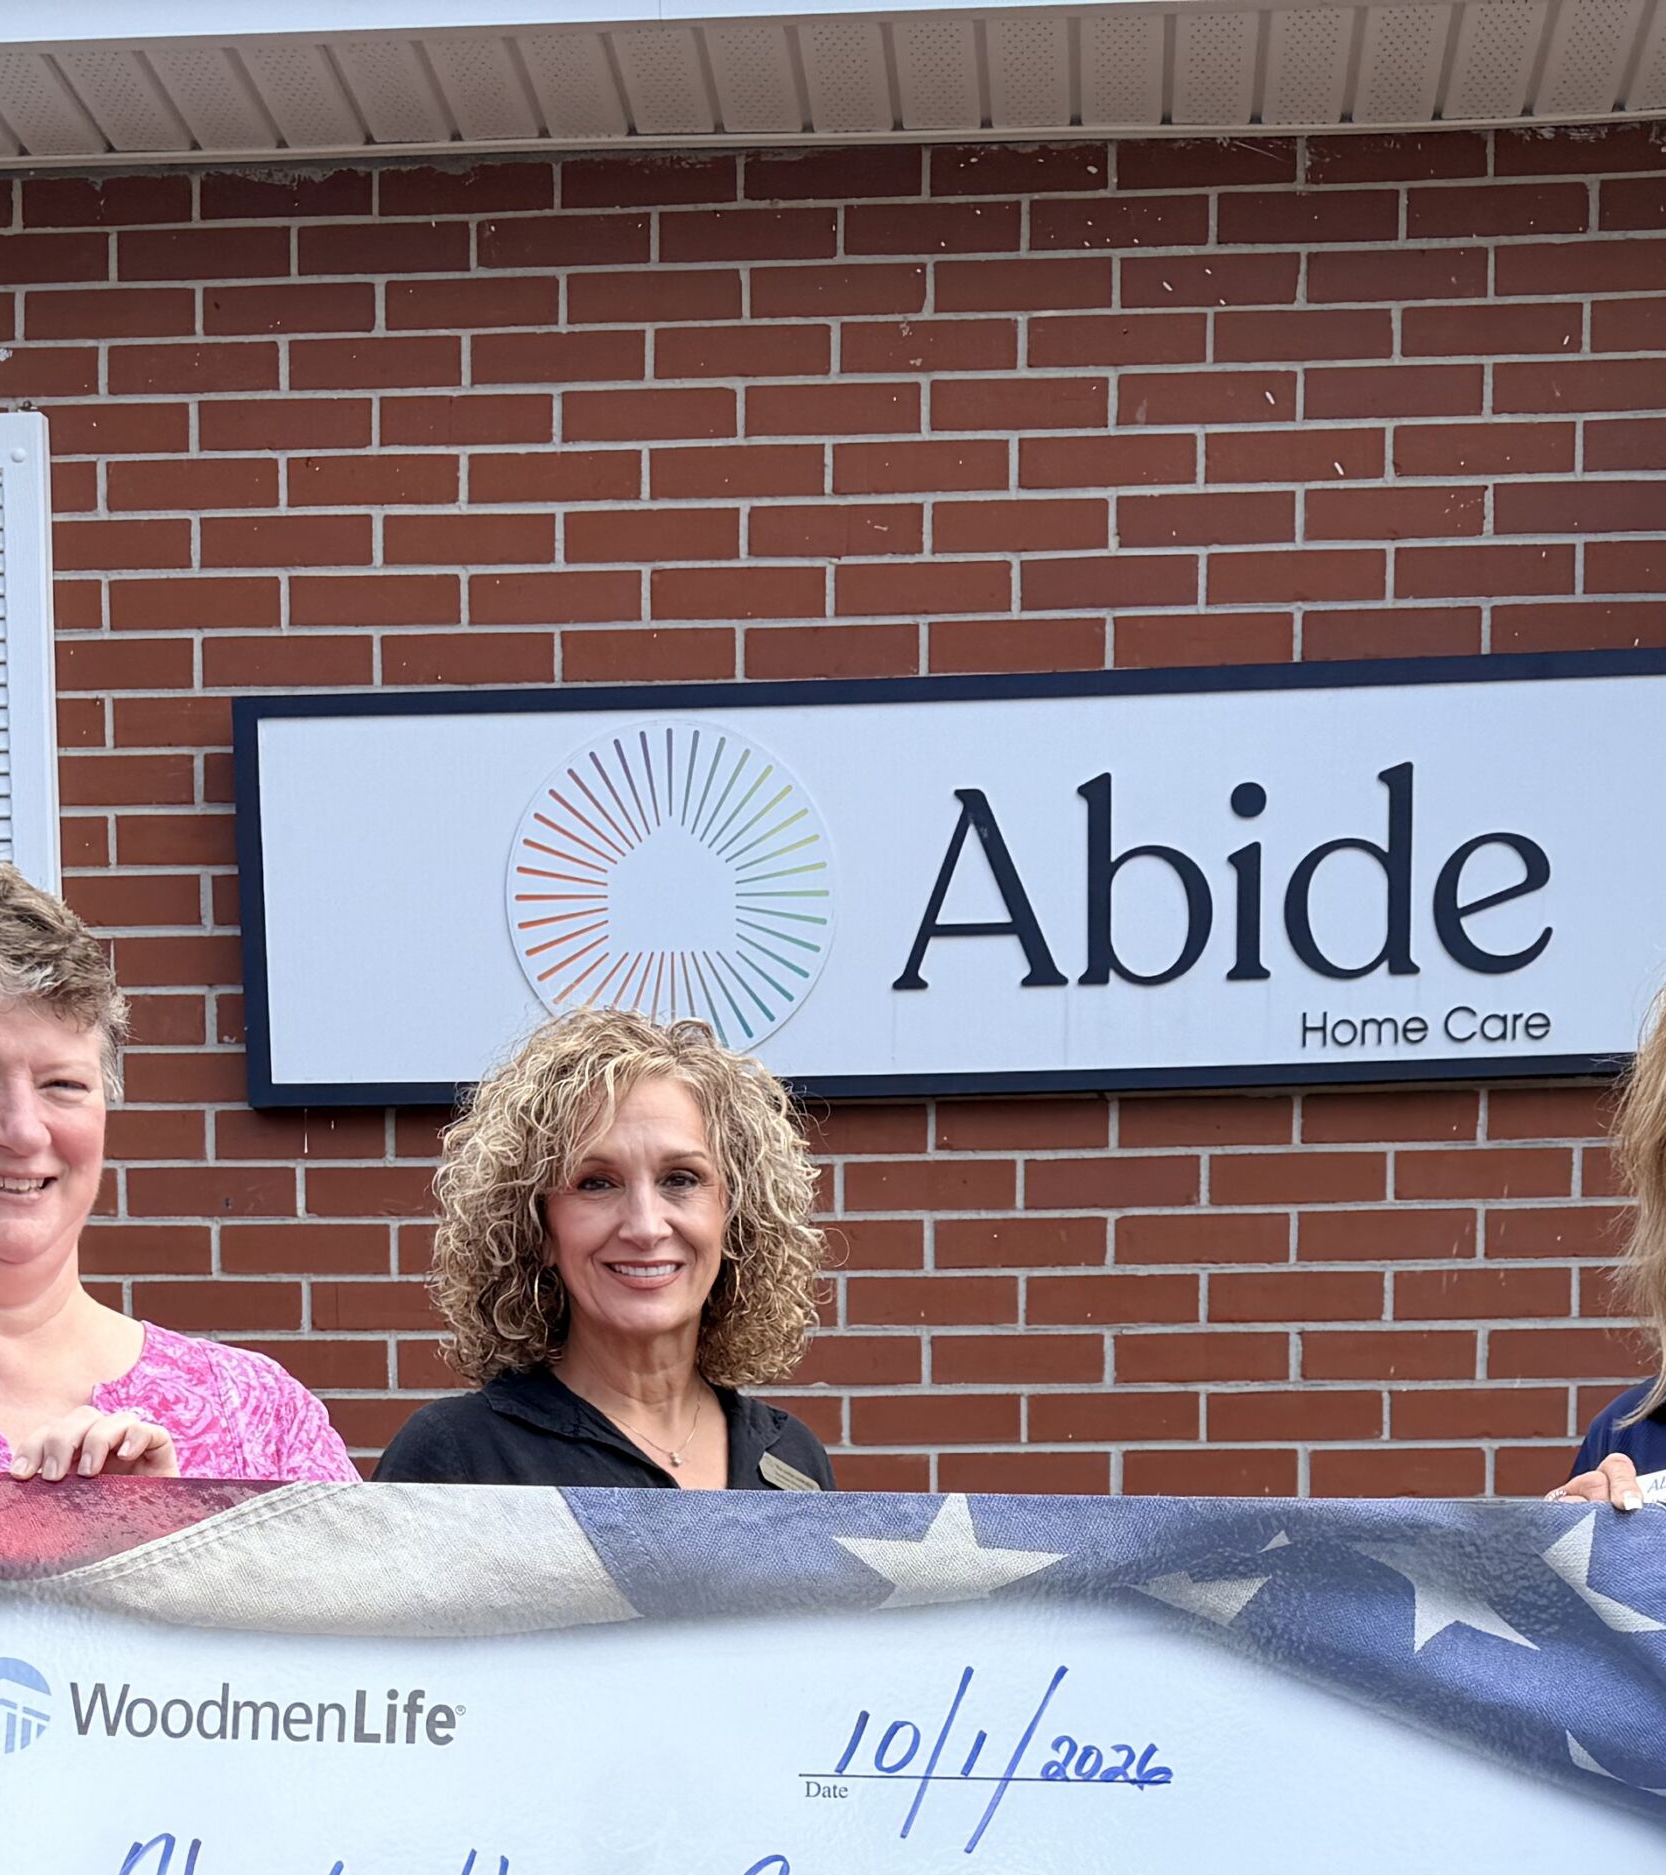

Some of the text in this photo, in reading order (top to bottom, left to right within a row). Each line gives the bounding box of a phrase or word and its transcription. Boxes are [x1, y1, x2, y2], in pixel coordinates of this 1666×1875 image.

[893, 761, 1552, 990] Abide
[1301, 1005, 1551, 1048] Home Care
[804, 1780, 849, 1800] Date
[834, 1665, 1174, 1854] 10/1/2026
